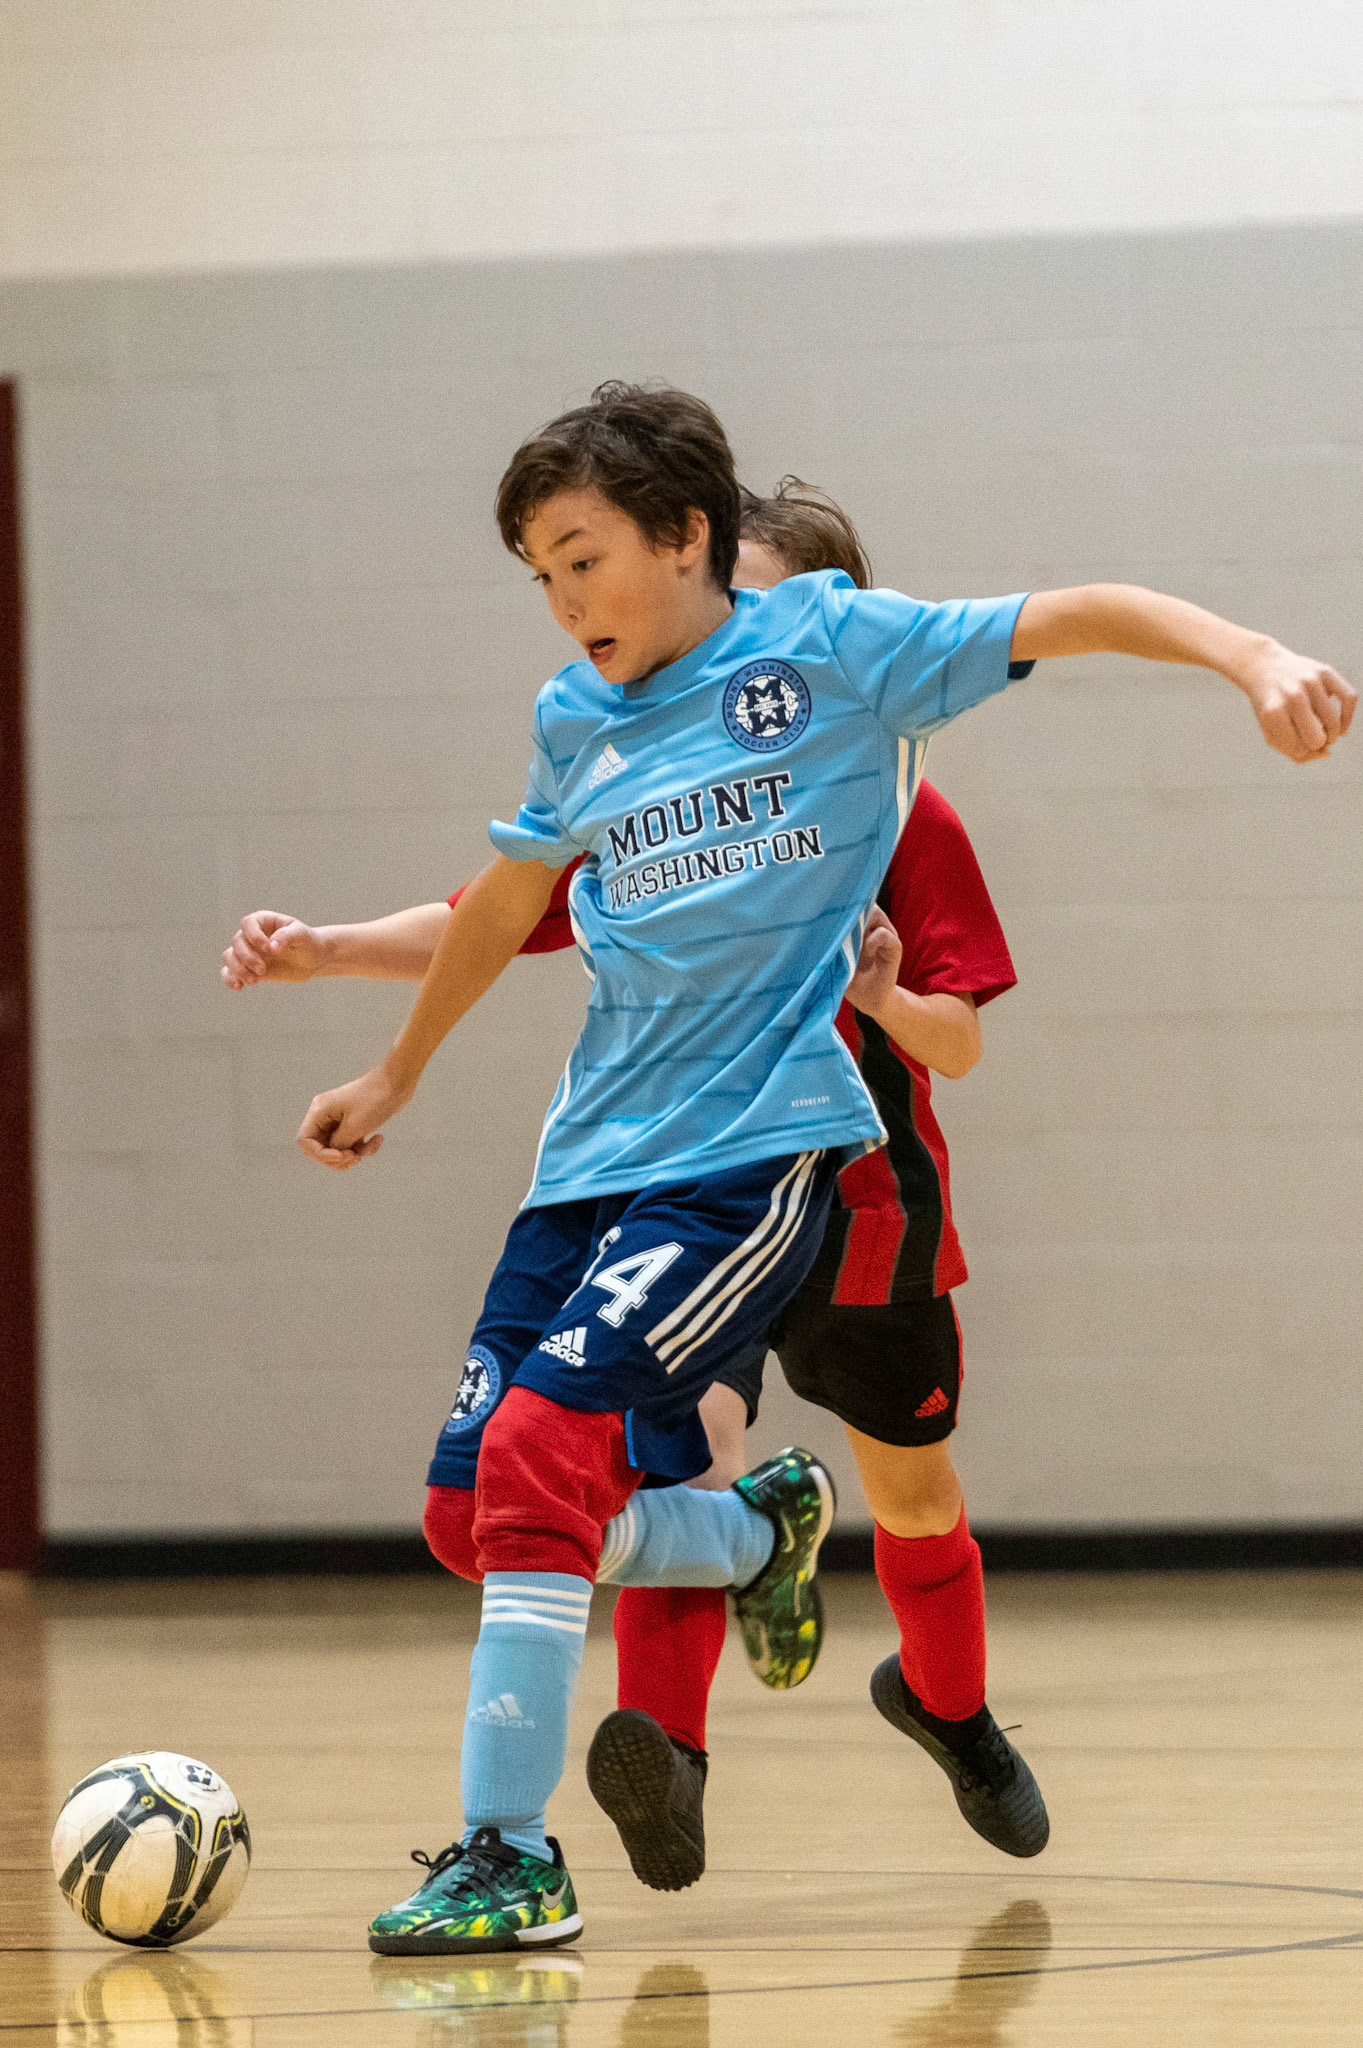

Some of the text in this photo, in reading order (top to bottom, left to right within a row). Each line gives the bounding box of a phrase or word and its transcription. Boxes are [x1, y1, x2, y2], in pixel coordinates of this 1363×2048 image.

[726, 664, 806, 718] MOUNT WASHINGTON
[738, 719, 804, 748] SOCCER CLUB
[588, 759, 629, 790] adidas
[607, 771, 793, 869] MOUNT
[609, 825, 825, 911] WASHINGTON
[561, 1226, 684, 1328] 4
[538, 1340, 587, 1367] adidas
[914, 1397, 949, 1418] adidas
[469, 1706, 536, 1729] adidas
